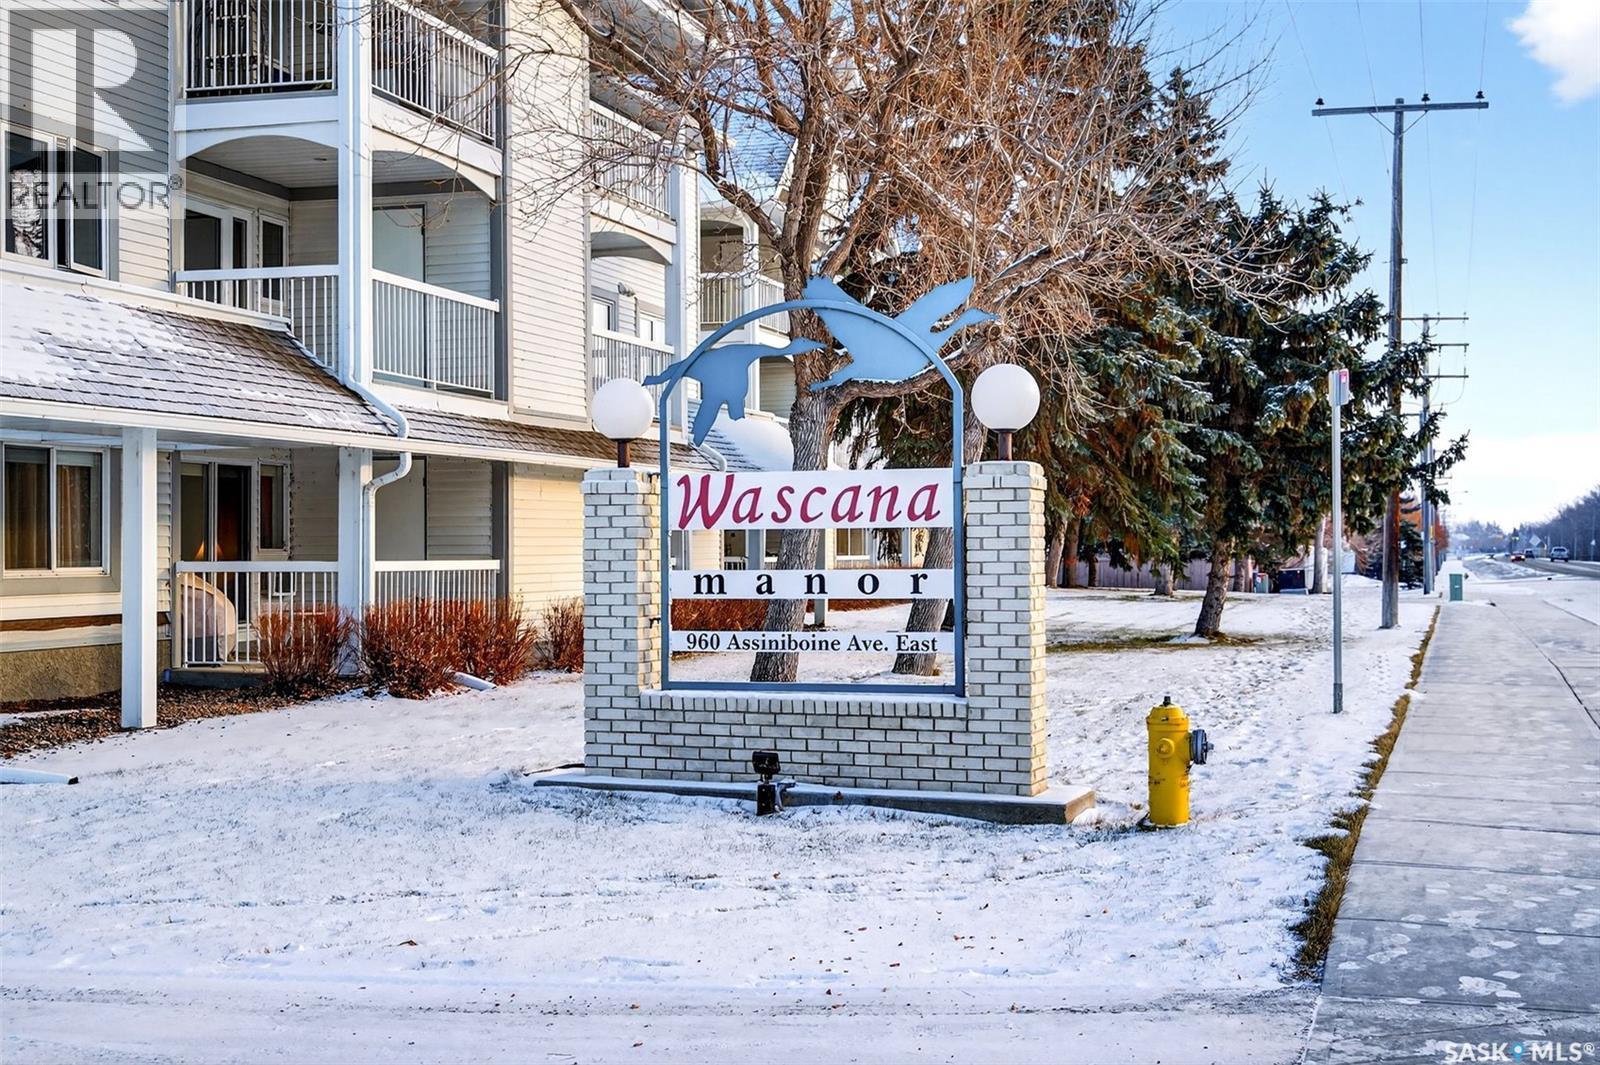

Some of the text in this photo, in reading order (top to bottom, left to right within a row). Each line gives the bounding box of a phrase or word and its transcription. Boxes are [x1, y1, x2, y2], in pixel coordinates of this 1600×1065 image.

[677, 473, 941, 530] Wascana
[693, 572, 929, 596] manor
[686, 632, 938, 653] 960 Assiniboine Ave. East
